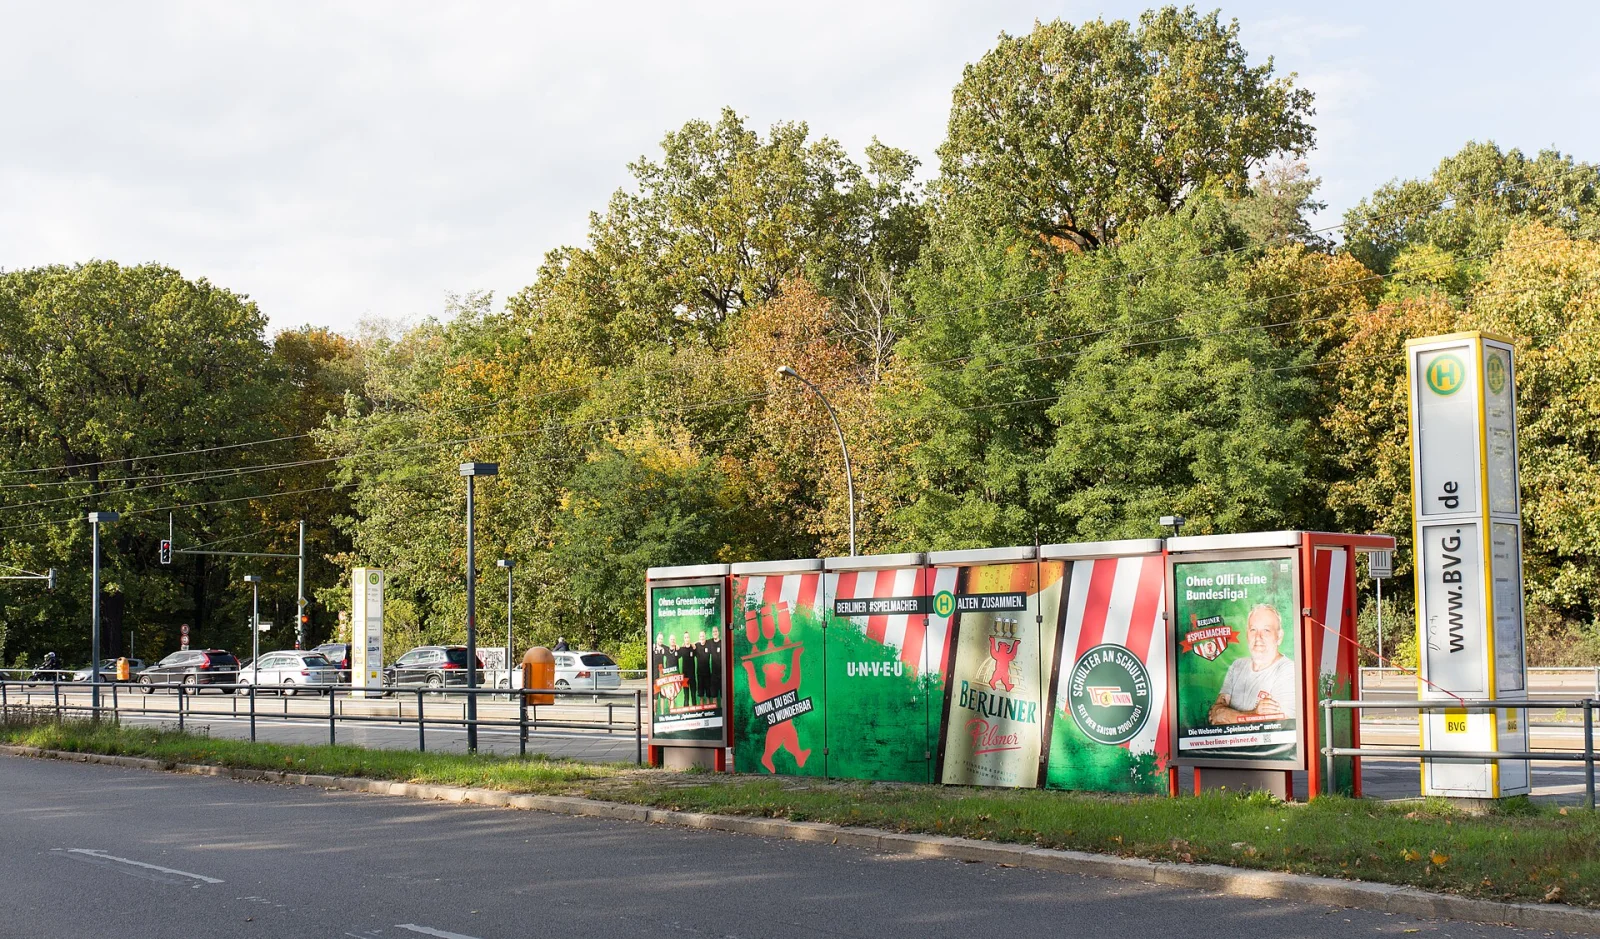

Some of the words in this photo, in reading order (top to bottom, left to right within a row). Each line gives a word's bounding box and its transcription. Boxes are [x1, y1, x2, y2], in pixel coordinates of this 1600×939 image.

[1186, 576, 1213, 587] Ohne
[1215, 574, 1234, 586] Olli
[1237, 573, 1267, 585] keine
[658, 597, 675, 607] Ohne
[675, 596, 717, 607] Greenkeeper
[1186, 588, 1248, 602] Bundesliga!
[658, 607, 676, 617] keine
[677, 606, 715, 617] Bundesliga!
[836, 602, 867, 614] BERLINER
[869, 600, 918, 612] #SPIELMACHER
[981, 595, 1024, 608] ZUSAMMEN.
[1073, 653, 1101, 697] SCHULTER
[1102, 650, 1115, 663] AN
[1116, 652, 1147, 697] SCHULTER
[754, 700, 775, 716] UNION,
[774, 696, 783, 709] DU
[782, 691, 796, 706] BIST
[959, 680, 1037, 724] BERLINER
[767, 712, 776, 725] SO
[775, 699, 812, 721] WUNDERBAR
[1077, 703, 1088, 719] SEIT
[1085, 716, 1097, 730] DER
[1096, 725, 1118, 736] SAISON
[1116, 704, 1143, 734] 2000/2001
[964, 717, 1019, 748] Pilsner
[1188, 728, 1198, 736] Die
[1198, 727, 1223, 735] Webserie
[1448, 721, 1466, 732] BVG
[1189, 736, 1258, 747] www.berliner-pilsner.de
